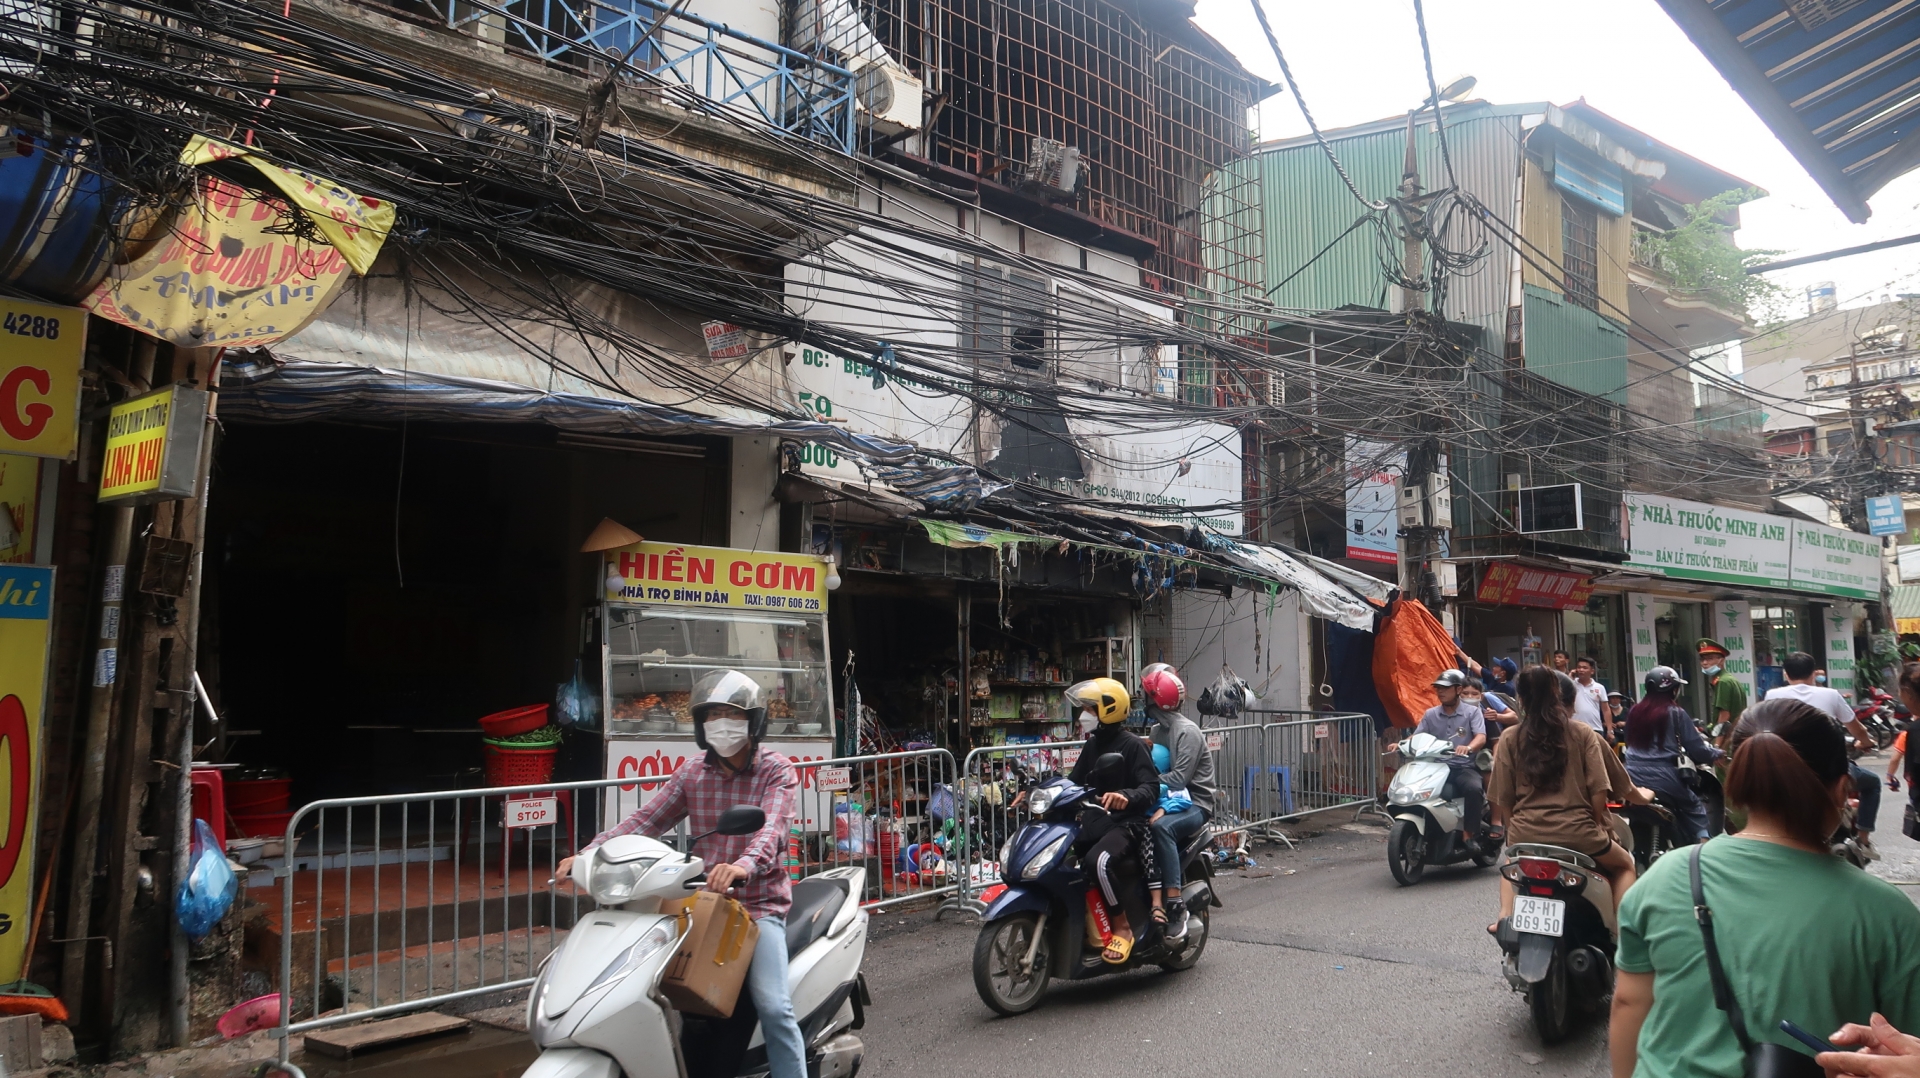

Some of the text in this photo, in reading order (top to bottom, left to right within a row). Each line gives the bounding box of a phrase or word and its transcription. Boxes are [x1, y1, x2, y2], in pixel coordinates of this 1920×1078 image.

[4, 312, 60, 340] 4288
[102, 436, 163, 489] LINH NHI
[1643, 503, 1785, 541] NHÀ THUỐC MINH ANH
[618, 547, 815, 592] HIỀN CƠM
[1656, 547, 1673, 563] BÁN
[1686, 550, 1711, 568] THUỐC
[1713, 555, 1737, 571] THÀNH
[1739, 554, 1759, 573] PHẨM
[618, 584, 819, 610] NHÀ TRỌ BÌNH DÂN TAXI: 0987 606 226
[1636, 628, 1651, 646] NHÀ
[1724, 633, 1745, 651] NHÀ
[1831, 637, 1849, 651] NHÀ
[1725, 654, 1751, 674] HUỐC
[517, 810, 547, 821] STOP
[1521, 899, 1557, 917] 29-H1
[1515, 914, 1560, 933] 869.50
